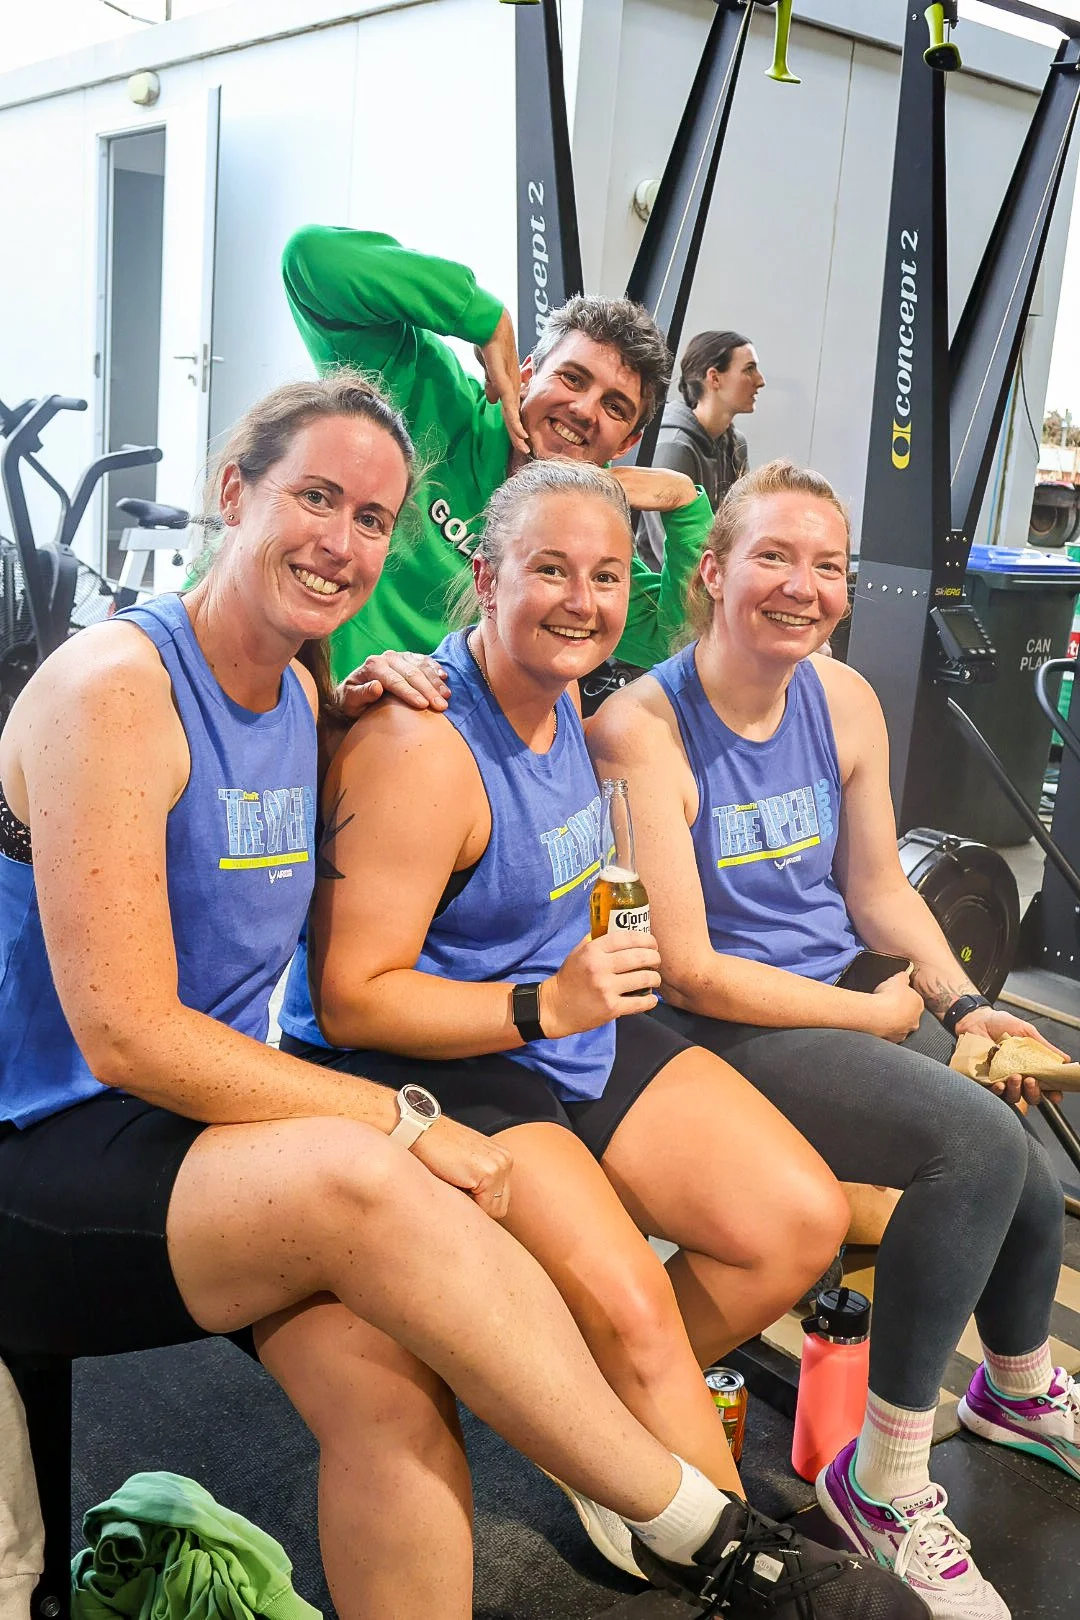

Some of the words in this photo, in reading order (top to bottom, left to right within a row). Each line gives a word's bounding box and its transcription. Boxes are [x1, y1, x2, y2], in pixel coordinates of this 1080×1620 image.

[528, 181, 545, 206] 2
[901, 229, 919, 252] 2
[530, 215, 551, 339] ncept
[895, 259, 918, 417] concept
[1026, 638, 1052, 653] CAN
[218, 788, 265, 856] THE
[712, 804, 763, 857] THE
[757, 786, 820, 849] OPEN
[539, 827, 581, 888] THE
[615, 911, 650, 931] Coro
